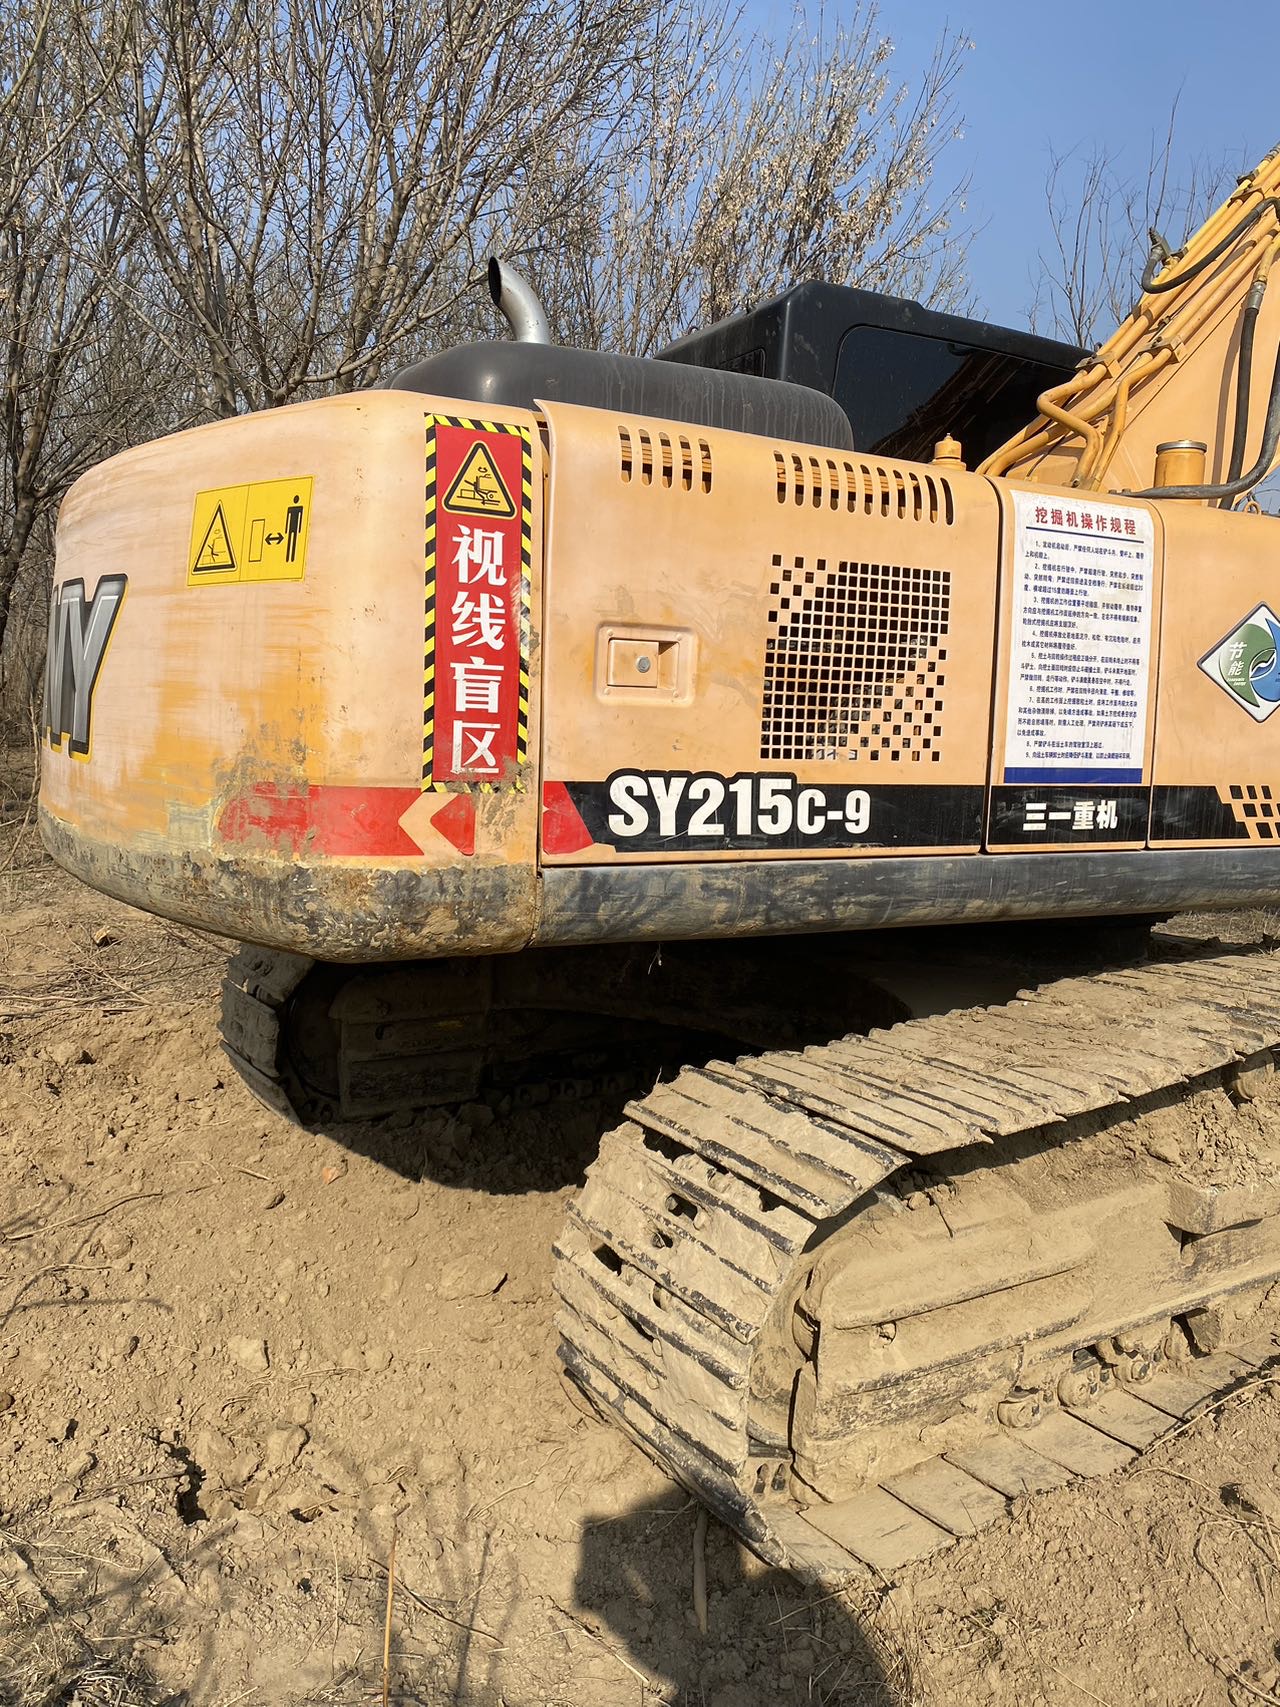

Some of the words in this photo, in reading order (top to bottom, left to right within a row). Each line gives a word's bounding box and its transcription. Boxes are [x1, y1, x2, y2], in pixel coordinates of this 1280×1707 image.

[1035, 506, 1137, 535] 挖掘机操作规程
[450, 524, 508, 776] 视线盲区
[1227, 641, 1248, 676] 节能
[608, 774, 872, 837] SY215C-9
[1022, 799, 1118, 832] 三一重机
